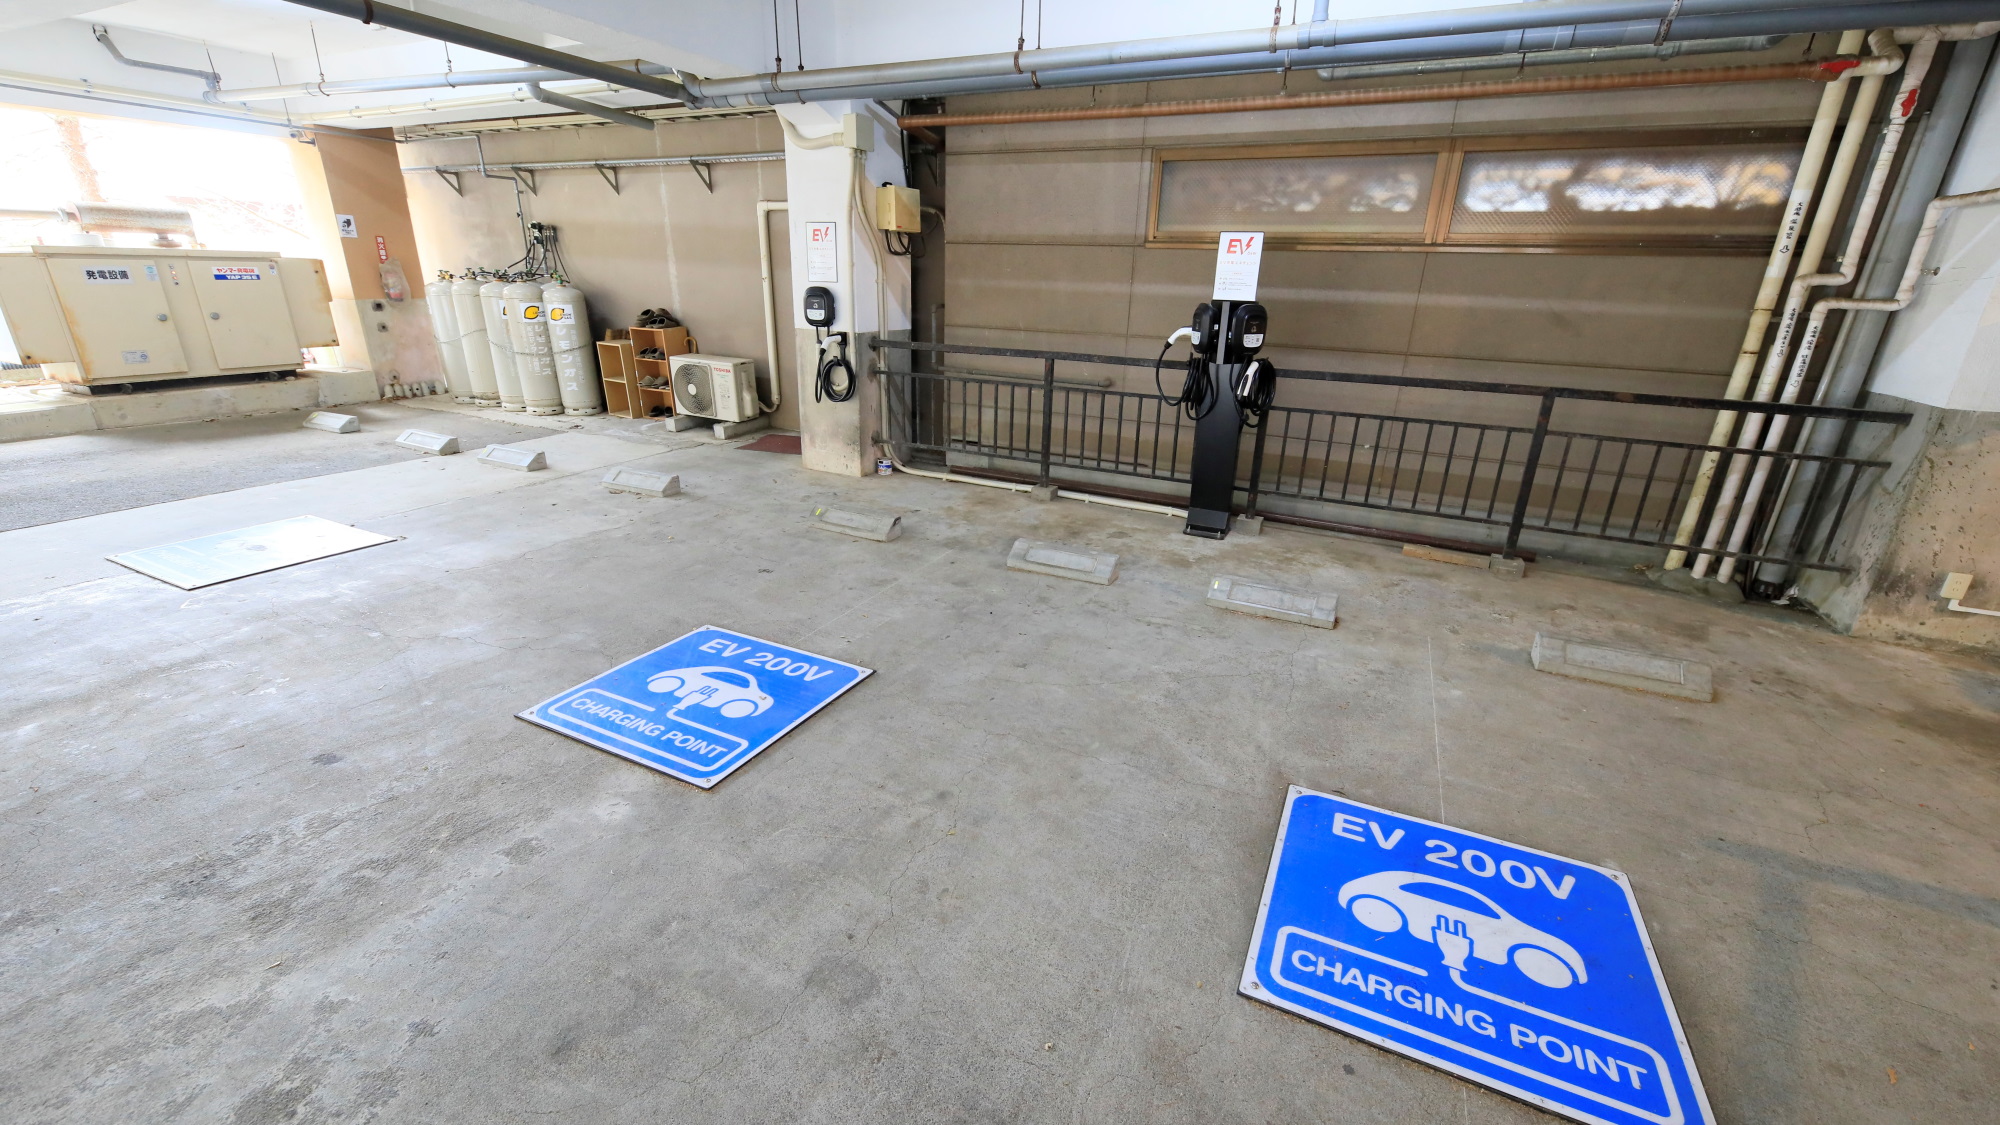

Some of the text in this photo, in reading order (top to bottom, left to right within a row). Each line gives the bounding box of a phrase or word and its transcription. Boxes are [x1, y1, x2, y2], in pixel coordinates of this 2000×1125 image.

[812, 226, 829, 242] EV
[1226, 236, 1255, 255] EV
[85, 269, 129, 280] 発電設備
[535, 324, 552, 375] レモンガス
[555, 326, 579, 391] レモンガス
[699, 638, 834, 682] EV 200V
[570, 698, 728, 758] CHARGING POINT
[1332, 812, 1576, 900] EV 200V
[1291, 949, 1648, 1090] CHARGING POINT
